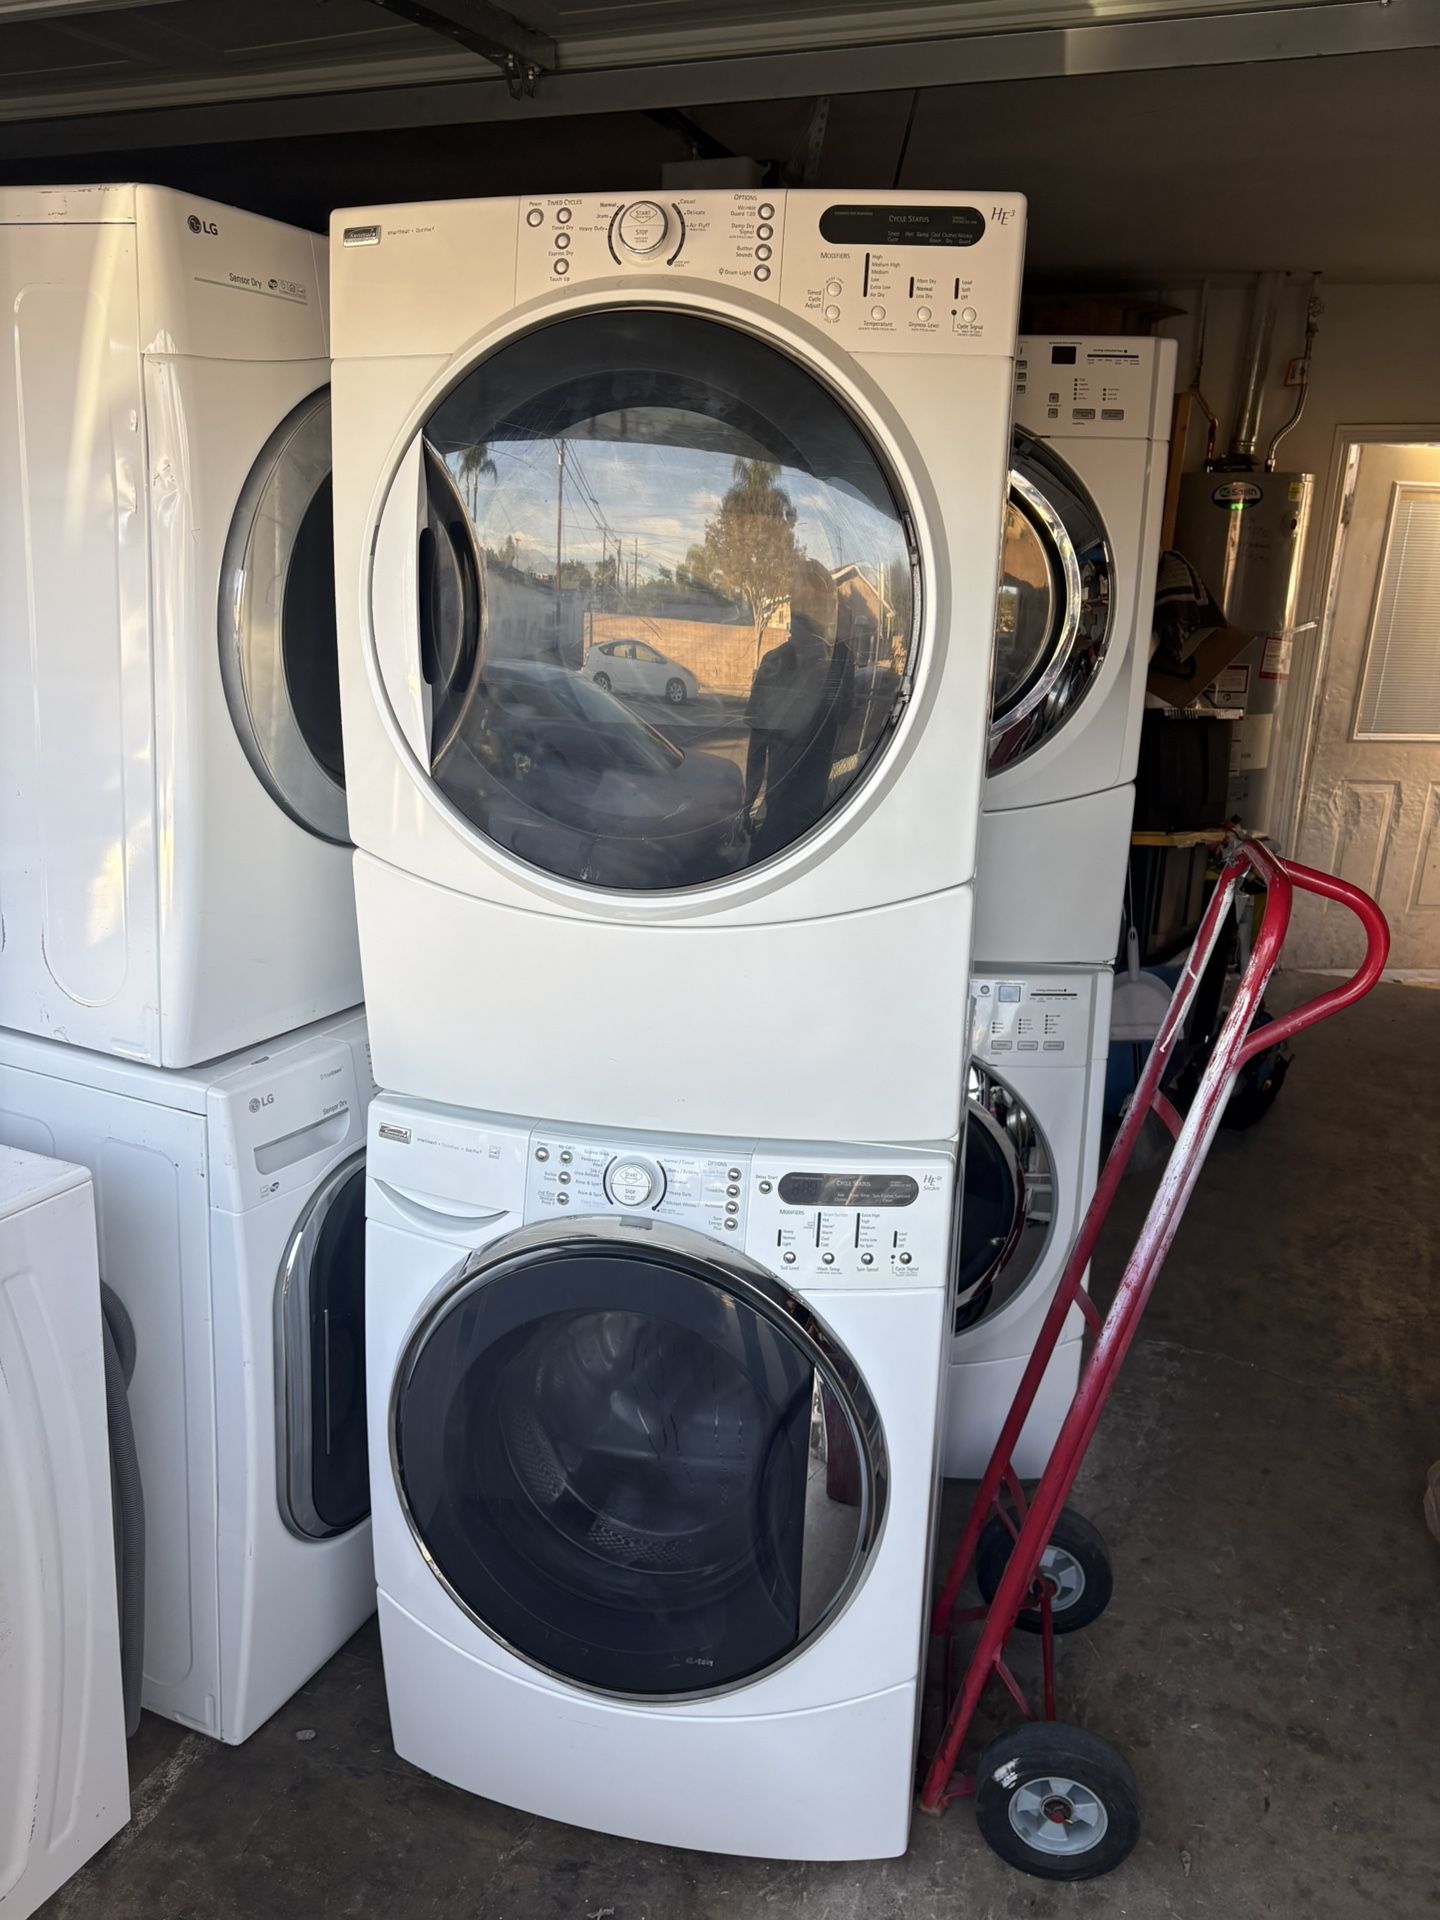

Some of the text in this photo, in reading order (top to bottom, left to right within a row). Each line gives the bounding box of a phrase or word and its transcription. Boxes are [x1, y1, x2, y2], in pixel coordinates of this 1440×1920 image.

[889, 215, 906, 223] CYCLE
[202, 220, 218, 236] LG
[229, 272, 262, 289] Sensor Dry
[261, 1094, 274, 1107] LG
